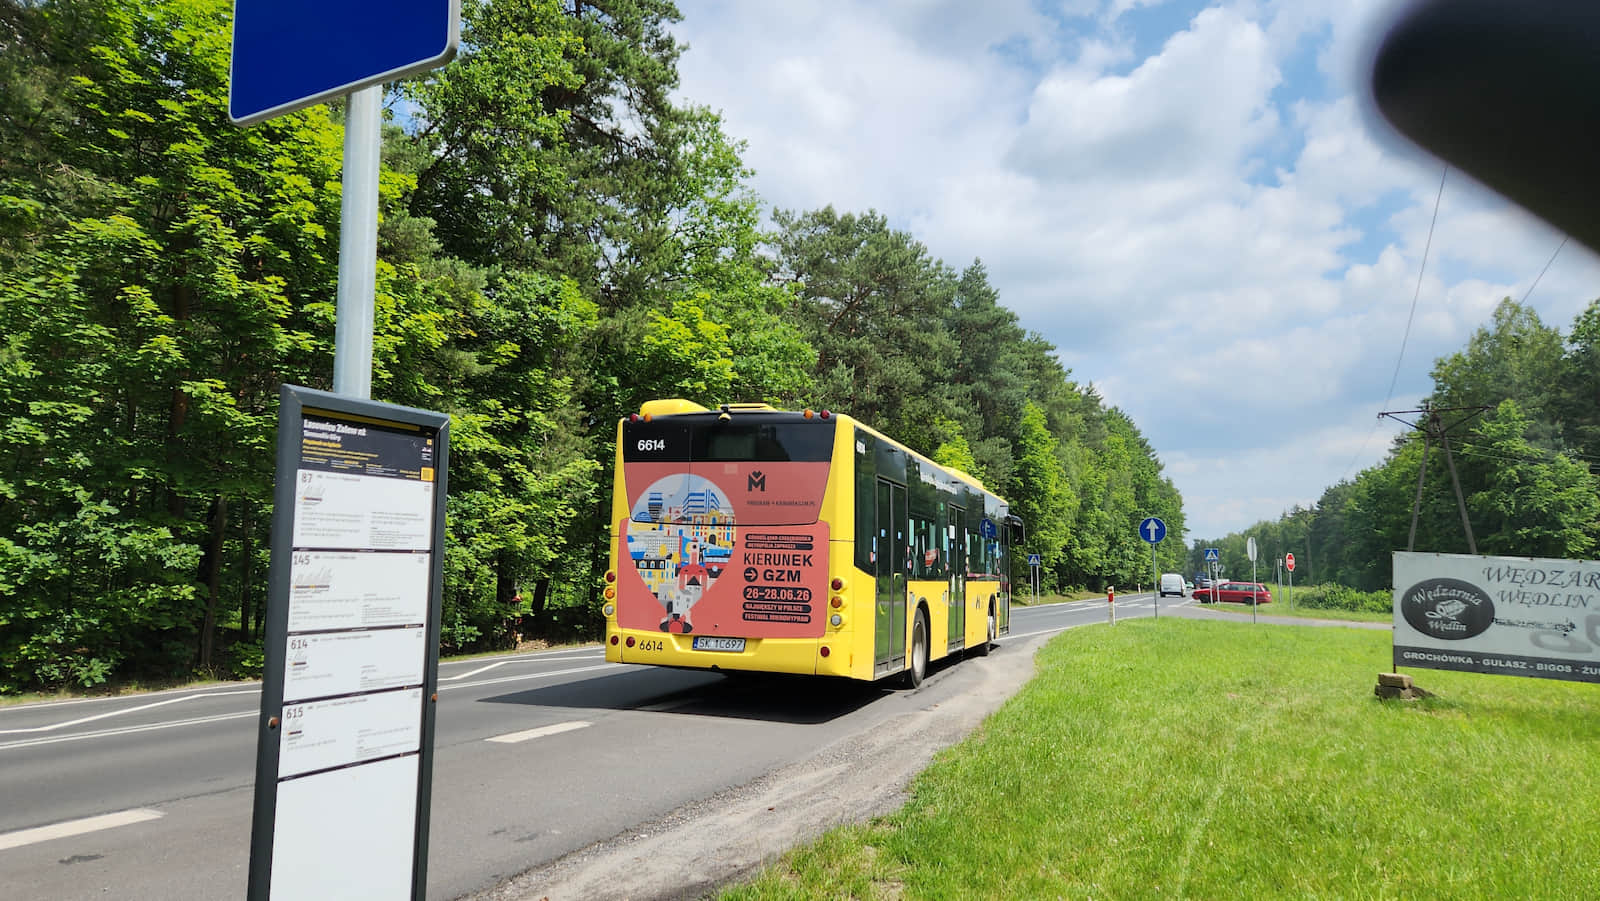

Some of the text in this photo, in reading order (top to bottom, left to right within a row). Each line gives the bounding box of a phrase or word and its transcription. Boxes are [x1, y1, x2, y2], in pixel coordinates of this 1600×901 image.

[637, 439, 665, 451] 6614
[301, 473, 313, 483] 87
[293, 555, 310, 566] 145
[743, 552, 813, 567] KIERUNEK
[763, 569, 801, 582] GZM
[746, 588, 810, 601] 26-28.06.26
[1496, 589, 1595, 609] WĘDLIN
[291, 639, 308, 650] 614
[639, 640, 663, 651] 6614
[699, 638, 743, 649] SK 1C697
[1403, 650, 1474, 665] GROCHÓWKA
[1482, 658, 1528, 670] GULASZ
[1536, 663, 1572, 673] BIGOS
[286, 706, 304, 719] 615
